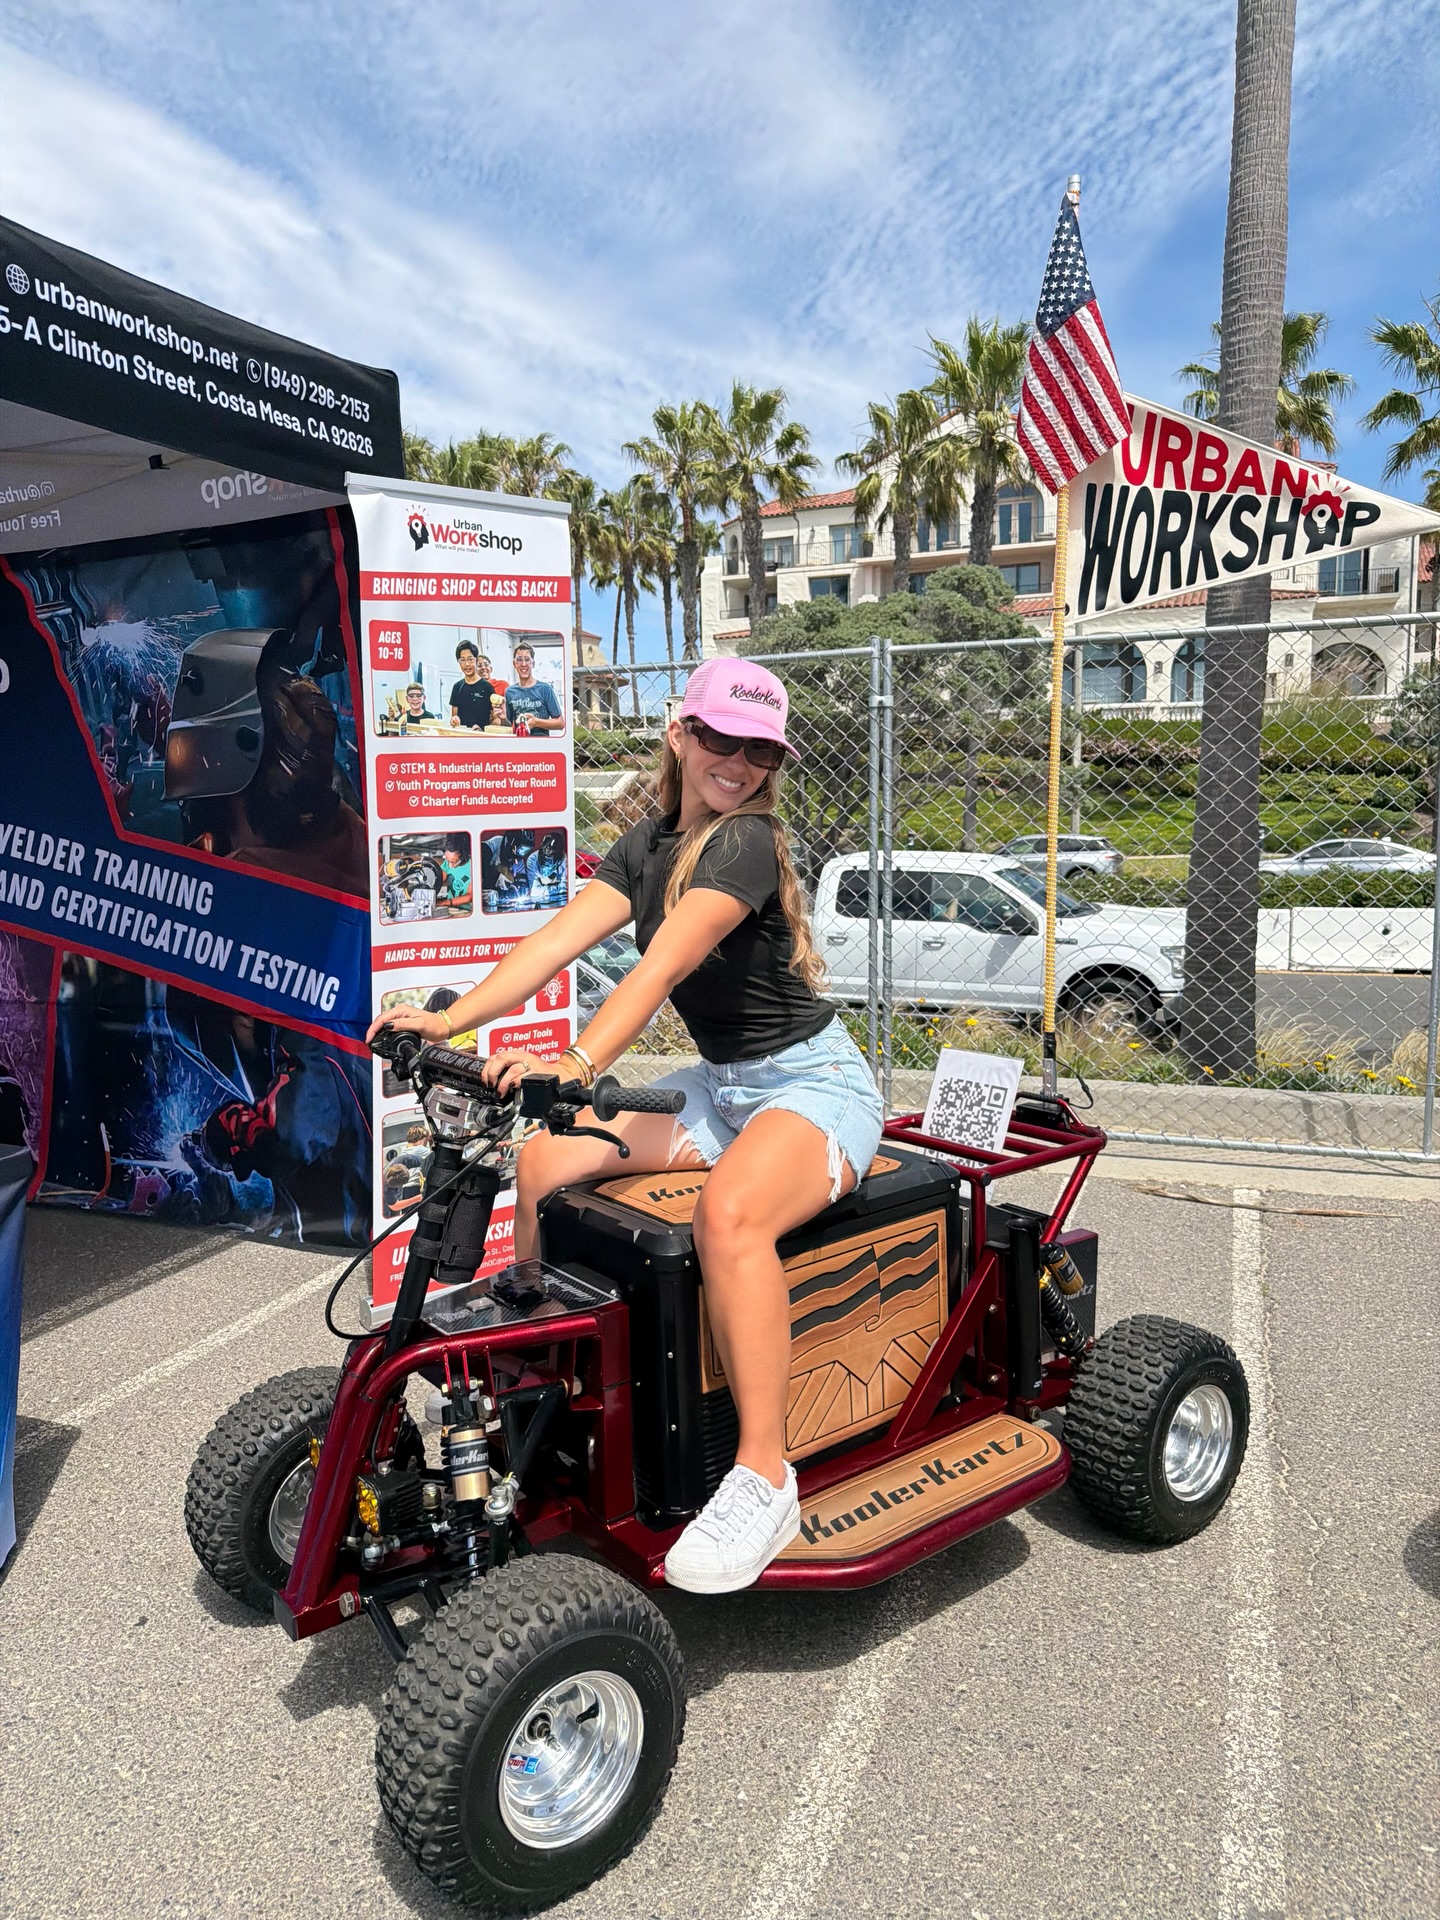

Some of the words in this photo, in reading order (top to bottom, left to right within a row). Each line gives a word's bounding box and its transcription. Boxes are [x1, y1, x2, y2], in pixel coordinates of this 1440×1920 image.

[35, 278, 239, 373] urbanworkshop.net
[48, 324, 129, 375] Clinton
[133, 355, 201, 402] Street,
[206, 381, 257, 418] Costa
[259, 400, 305, 437] Mesa,
[308, 417, 330, 443] CA
[331, 425, 374, 457] 92626
[264, 362, 307, 400] (949)
[308, 381, 370, 423] 296-2153
[1121, 402, 1309, 498] URBAN
[453, 519, 482, 531] Urban
[430, 523, 523, 555] Workshop
[373, 577, 437, 595] BRINGING
[441, 578, 476, 596] SHOP
[479, 580, 518, 597] CLASS
[521, 581, 558, 598] BACK!
[378, 631, 402, 644] AGES
[378, 646, 403, 660] 10-16
[400, 763, 425, 774] STEM
[428, 763, 437, 773] &
[439, 762, 483, 773] Industrial
[484, 762, 504, 773] Arts
[506, 761, 555, 774] Exploration
[396, 779, 421, 791] Youth
[423, 779, 470, 793] Programs
[472, 778, 507, 789] Offered
[508, 778, 528, 788] Year
[530, 777, 556, 787] Round
[421, 795, 459, 806] Charter
[461, 794, 488, 805] Funds
[490, 793, 533, 805] Accepted
[93, 848, 214, 916] TRAINING
[51, 885, 234, 972] CERTIFICATION
[237, 944, 340, 1012] TESTING
[384, 947, 436, 963] HANDS-ON
[439, 945, 471, 959] SKILLS
[472, 943, 491, 957] FOR
[493, 943, 517, 955] YOU
[513, 1032, 531, 1042] Real
[532, 1027, 553, 1040] Tools
[526, 1040, 558, 1052] Projects
[454, 1056, 473, 1068] MY
[540, 1052, 561, 1062] Skills
[800, 1431, 1033, 1545] KoolerKartz
